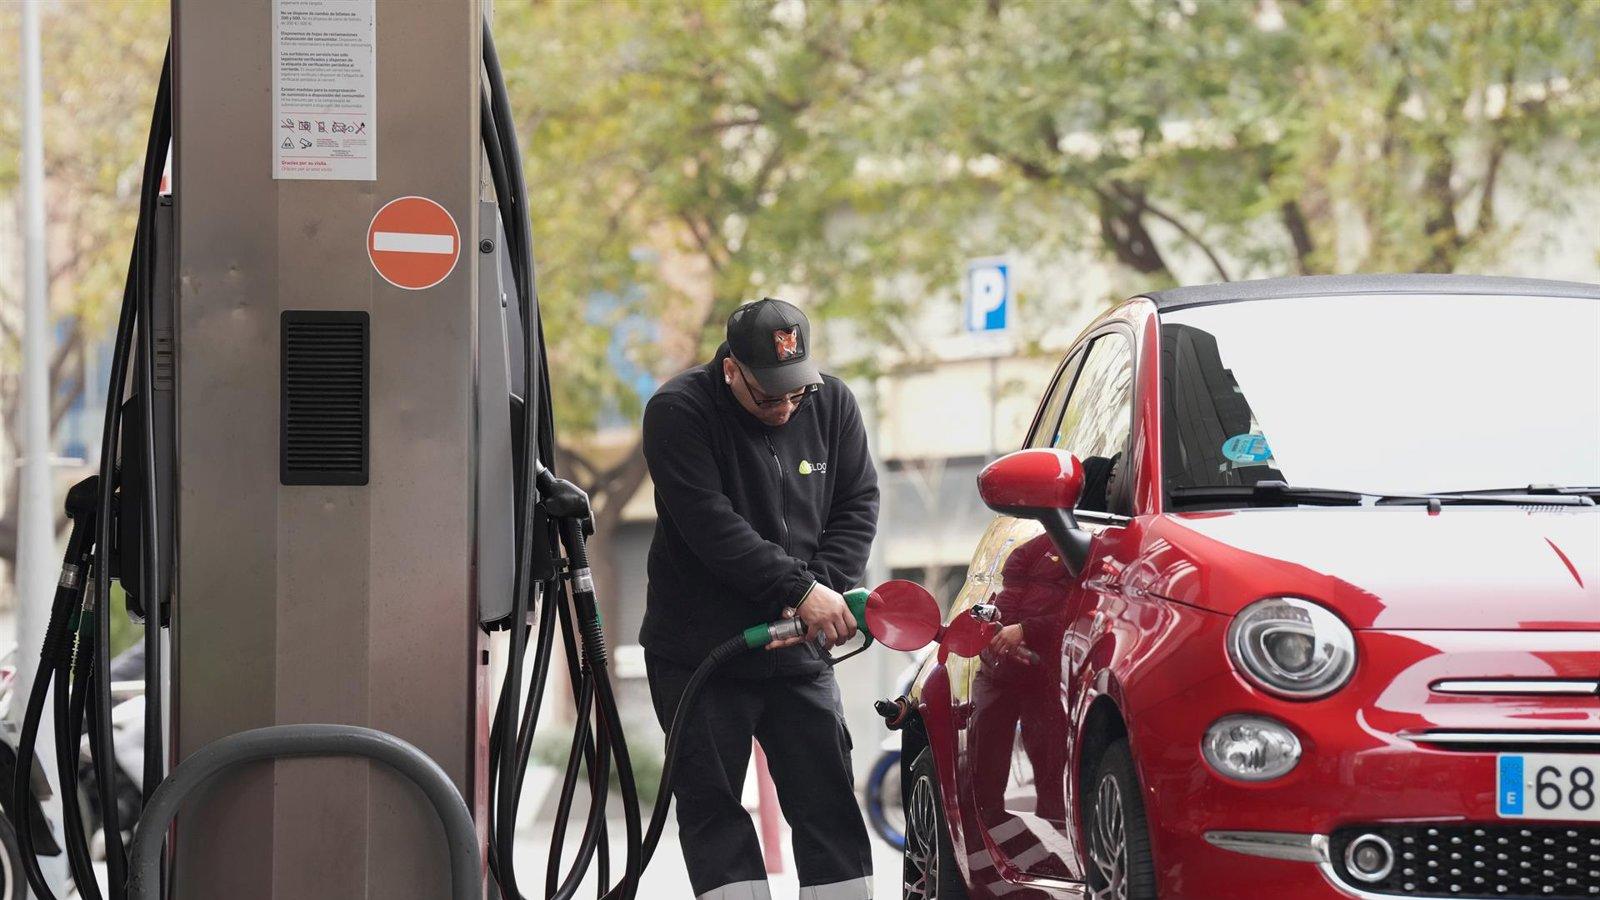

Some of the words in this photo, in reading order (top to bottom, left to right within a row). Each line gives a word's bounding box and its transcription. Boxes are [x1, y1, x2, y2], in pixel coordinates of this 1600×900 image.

[972, 271, 1004, 329] P
[1506, 792, 1516, 804] E
[1536, 765, 1595, 811] 68
